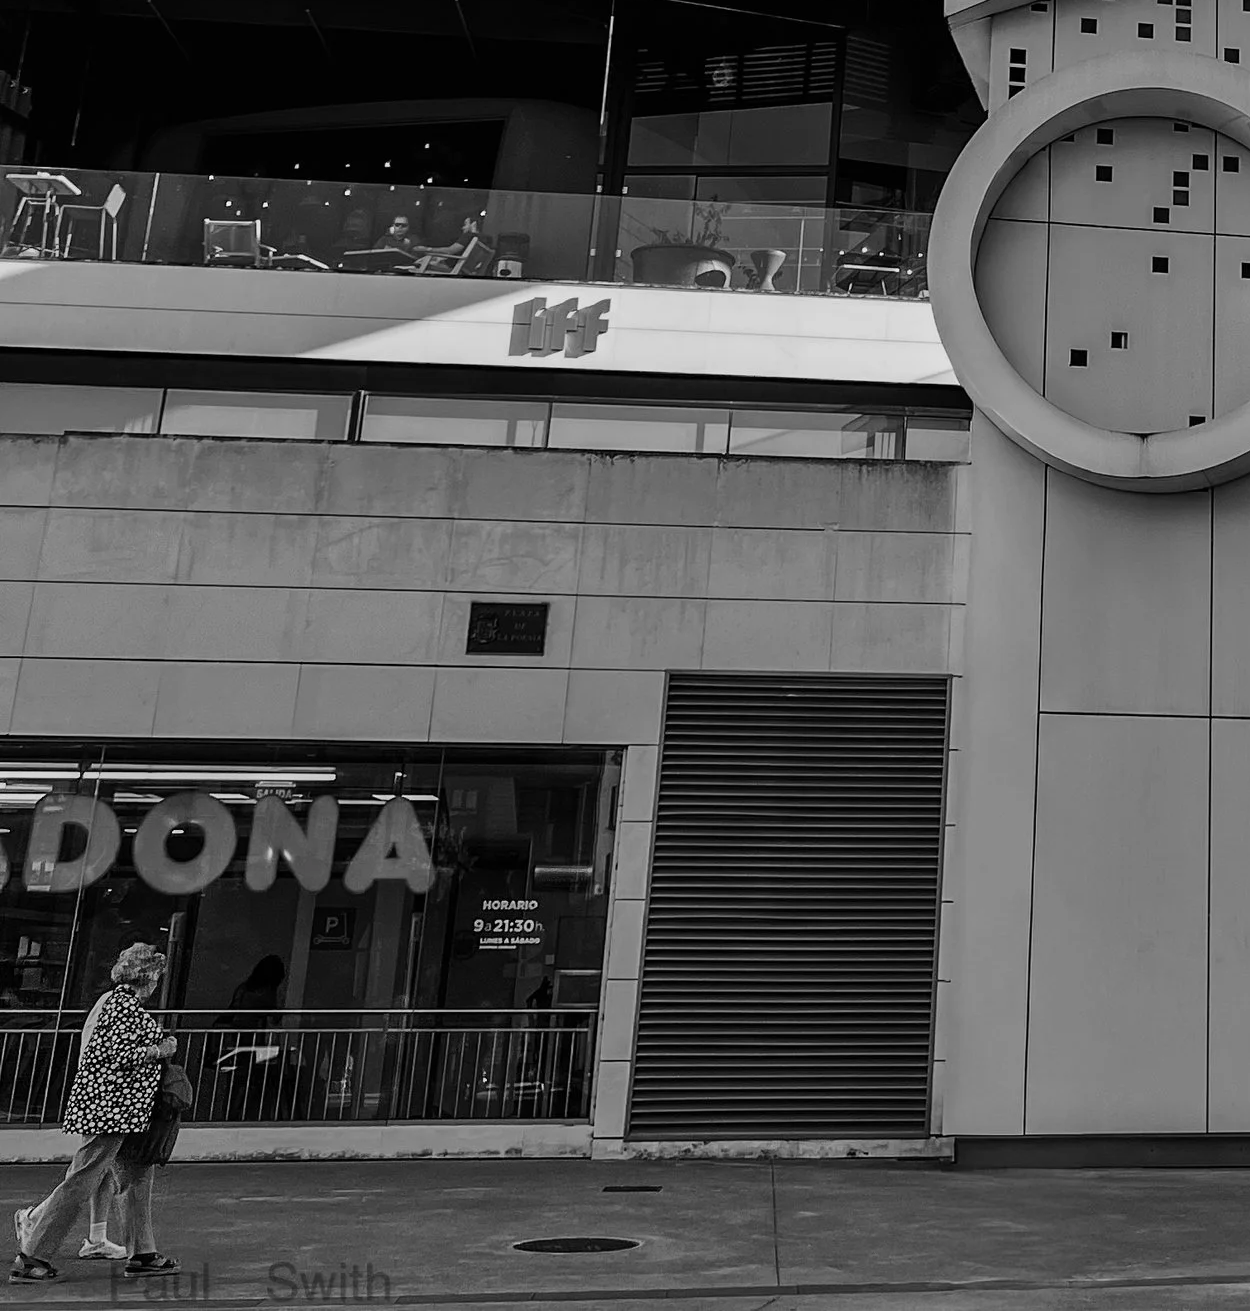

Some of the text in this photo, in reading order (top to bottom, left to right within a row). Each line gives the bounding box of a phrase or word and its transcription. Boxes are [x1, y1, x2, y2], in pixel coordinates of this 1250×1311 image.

[0, 790, 436, 895] DONA
[482, 899, 539, 911] HORARIO
[325, 916, 339, 933] P
